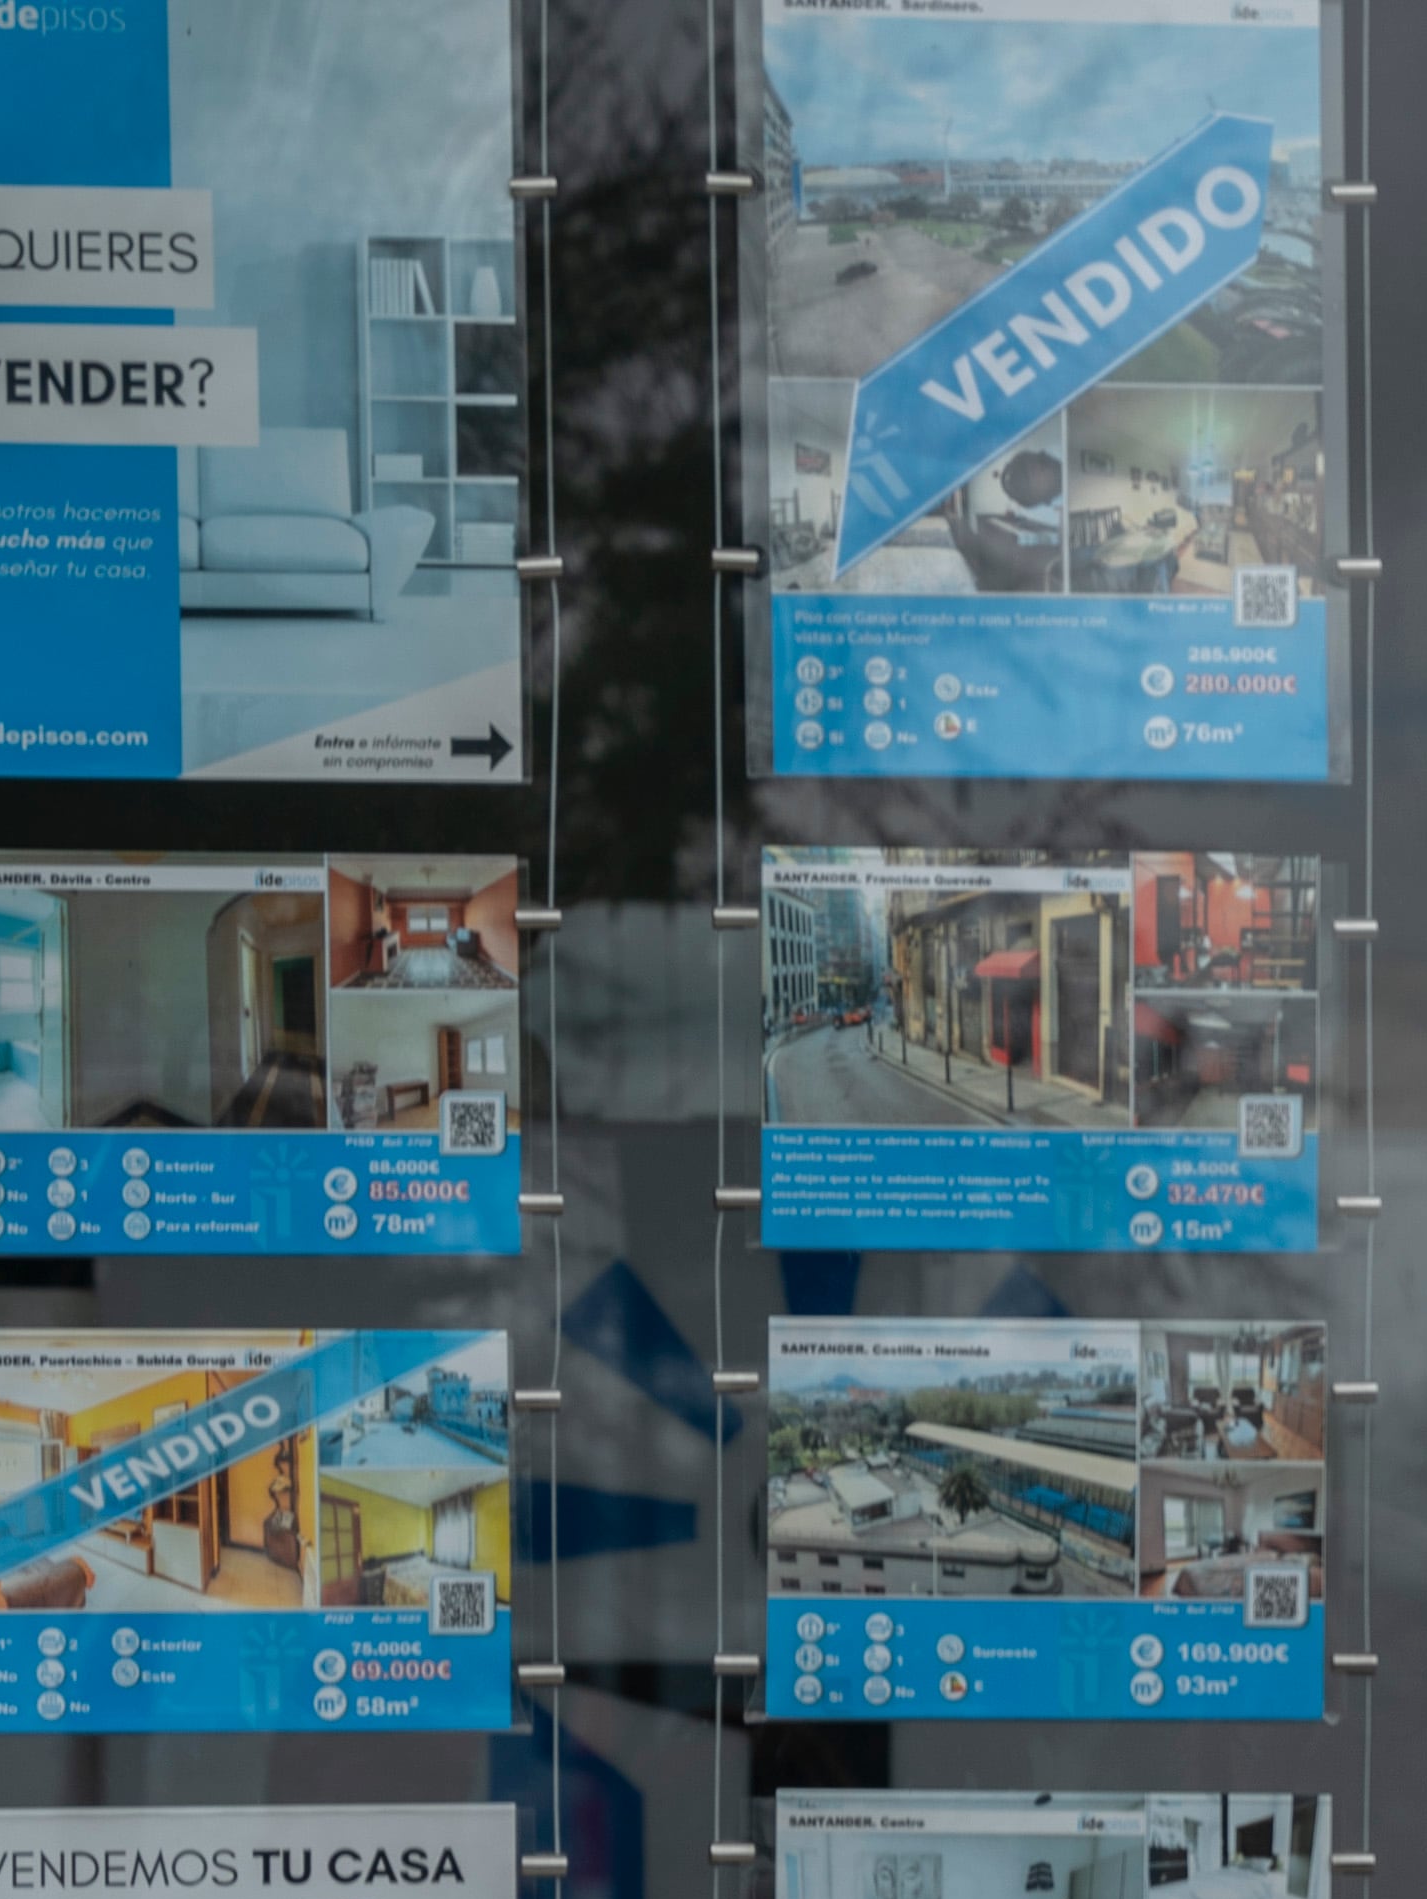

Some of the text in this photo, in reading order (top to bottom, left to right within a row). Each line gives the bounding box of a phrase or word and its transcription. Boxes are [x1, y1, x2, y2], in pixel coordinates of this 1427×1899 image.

[919, 166, 1260, 422] VENDIDO
[64, 503, 161, 522] hacemos
[56, 531, 106, 549] más
[112, 534, 153, 552] que
[67, 562, 88, 579] tu
[93, 563, 152, 580] casa.
[314, 734, 442, 751] Entra e infórmate
[1182, 723, 1243, 744] 76m²
[323, 754, 434, 772] sin compromiso
[51, 873, 91, 886] Dávila
[105, 875, 151, 887] Centro
[774, 872, 861, 884] SANTANDER.
[865, 874, 929, 886] Francisco
[155, 1161, 215, 1174] Exterior
[370, 1180, 469, 1201] 85.000€
[156, 1220, 260, 1233] Para reformar
[372, 1214, 434, 1234] 78m²
[1172, 1220, 1232, 1241] 15m²
[781, 1343, 990, 1358] SANTANDER. Castilla Hermida
[40, 1354, 122, 1368] Puertochico
[136, 1354, 183, 1368] Subida
[70, 1394, 281, 1511] VENDIDO
[142, 1638, 202, 1652] Exterior
[1177, 1642, 1288, 1663] 169.900€
[141, 1670, 176, 1683] Este
[352, 1660, 451, 1681] 69.000€
[1176, 1675, 1238, 1694] 93m²
[356, 1695, 418, 1716] 58m²
[789, 1817, 925, 1829] SANTANDER. Centro
[253, 1849, 311, 1884] TU
[328, 1848, 464, 1884] CASA
